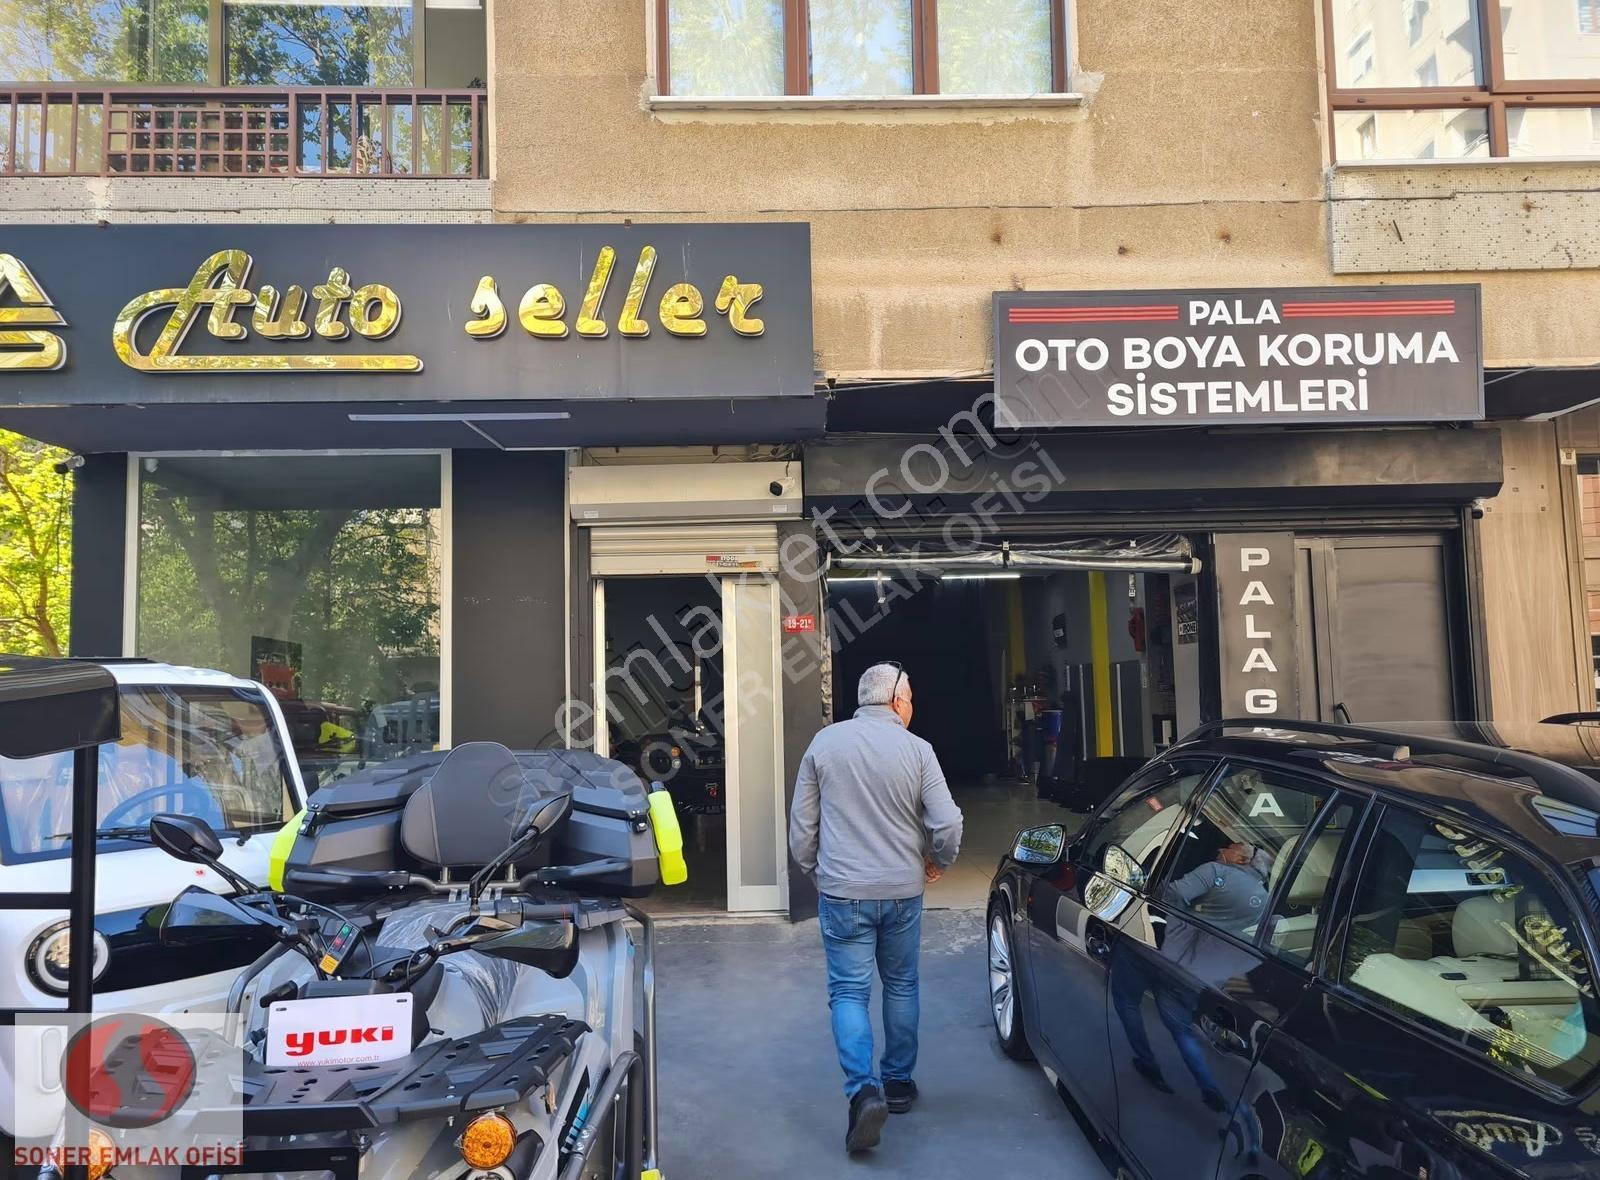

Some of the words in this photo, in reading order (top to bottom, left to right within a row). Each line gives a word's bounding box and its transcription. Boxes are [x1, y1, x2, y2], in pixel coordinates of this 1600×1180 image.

[113, 248, 424, 374] Auto
[464, 244, 765, 338] seller
[1188, 299, 1281, 326] PALA
[1015, 337, 1110, 371] OTO
[1123, 334, 1246, 370] BOYA
[1258, 330, 1460, 368] KORUMA
[1106, 368, 1369, 416] SİSTEMLERİ
